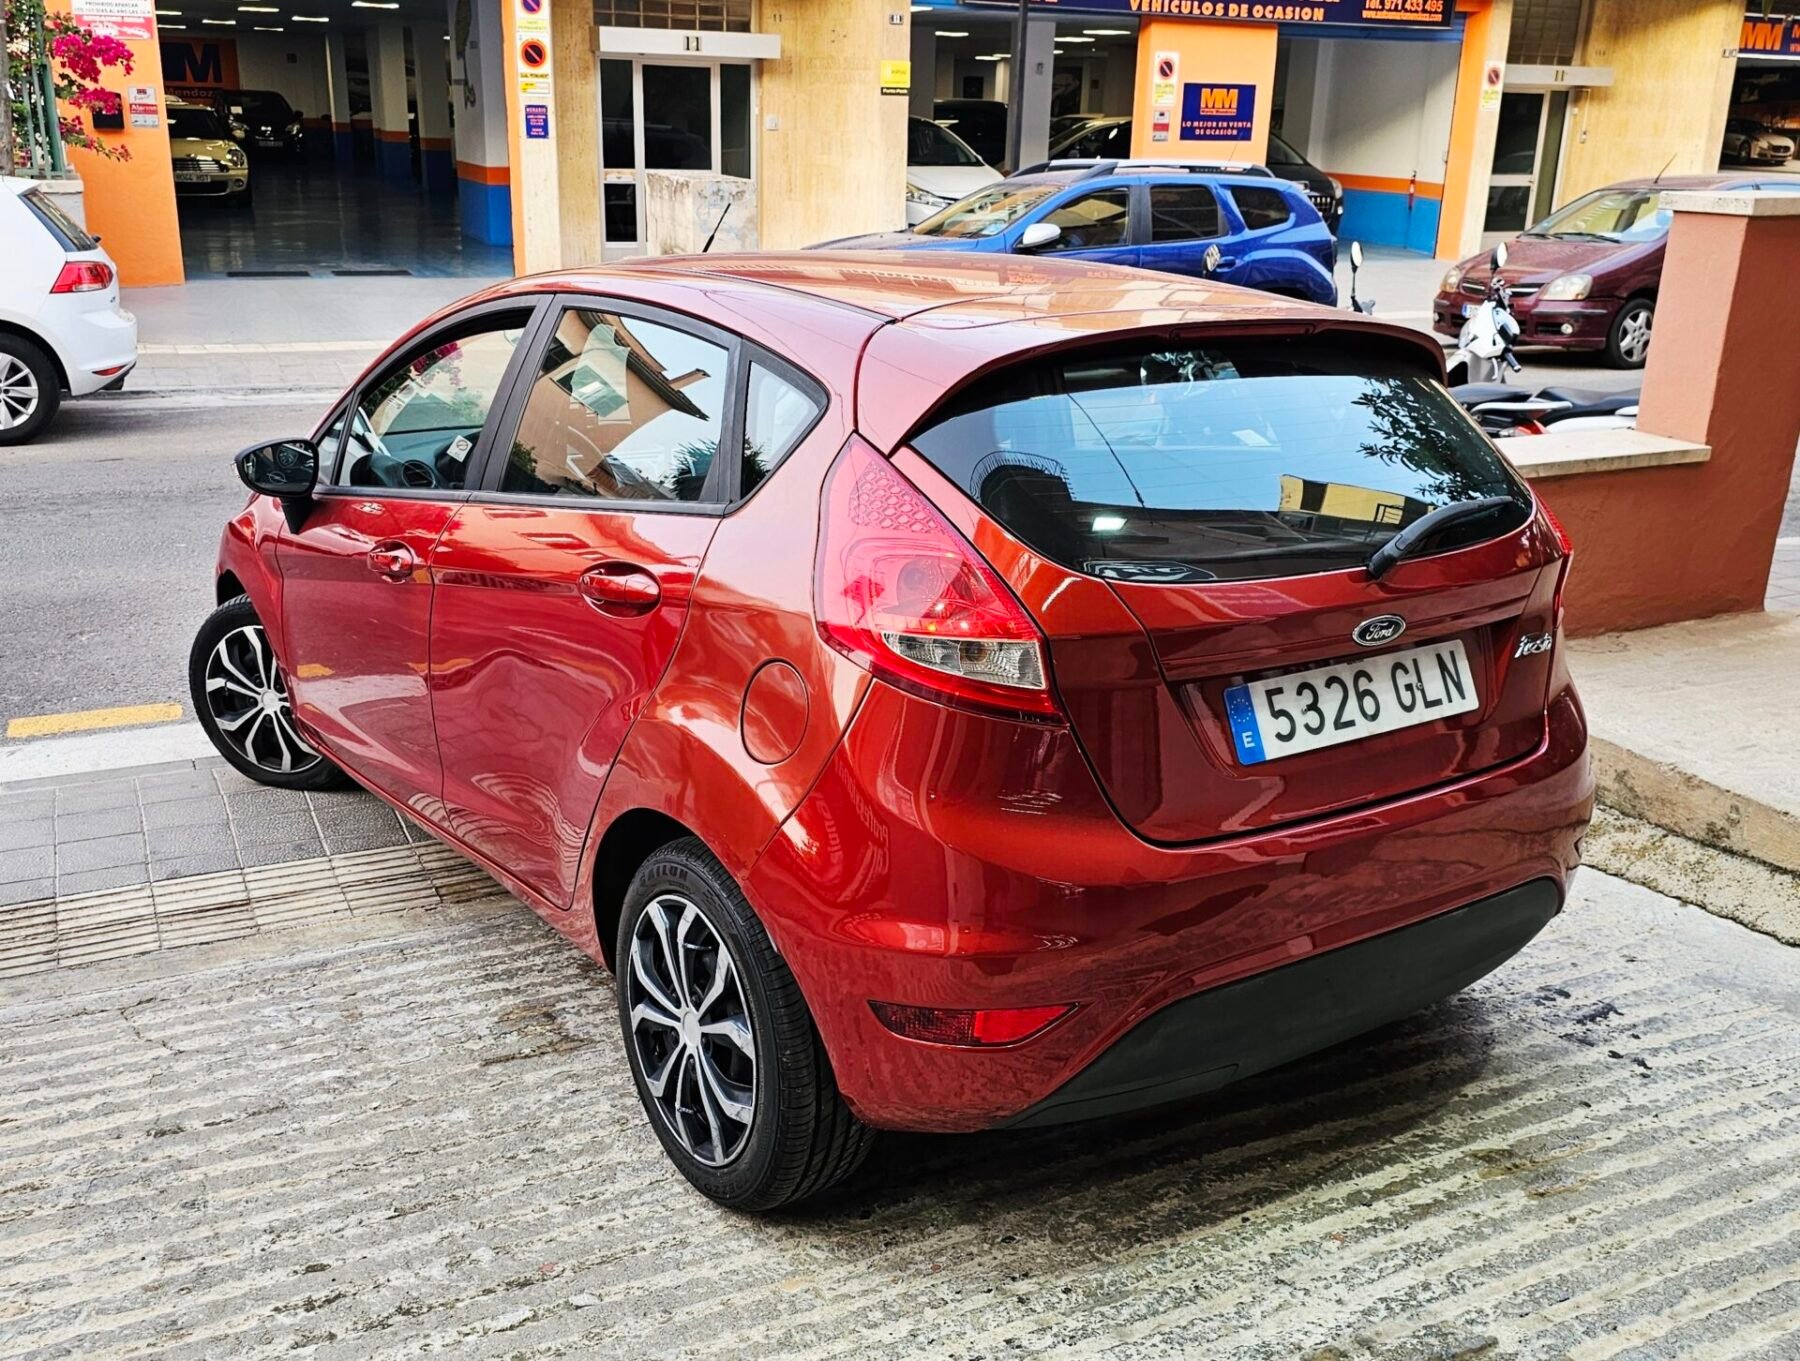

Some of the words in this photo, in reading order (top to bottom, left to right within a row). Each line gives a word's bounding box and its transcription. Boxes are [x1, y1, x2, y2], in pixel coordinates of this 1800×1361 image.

[1130, 0, 1225, 17] VEHICULOS
[1228, 3, 1249, 18] DE
[1384, 0, 1402, 10] 971
[1404, 0, 1423, 11] 433
[1425, 0, 1443, 12] 495
[773, 14, 783, 22] 11
[686, 36, 700, 51] 11
[1200, 88, 1239, 108] MM
[1366, 622, 1394, 640] Ford
[1264, 668, 1381, 743] 5326
[1390, 650, 1467, 714] GLN
[1241, 730, 1256, 749] E
